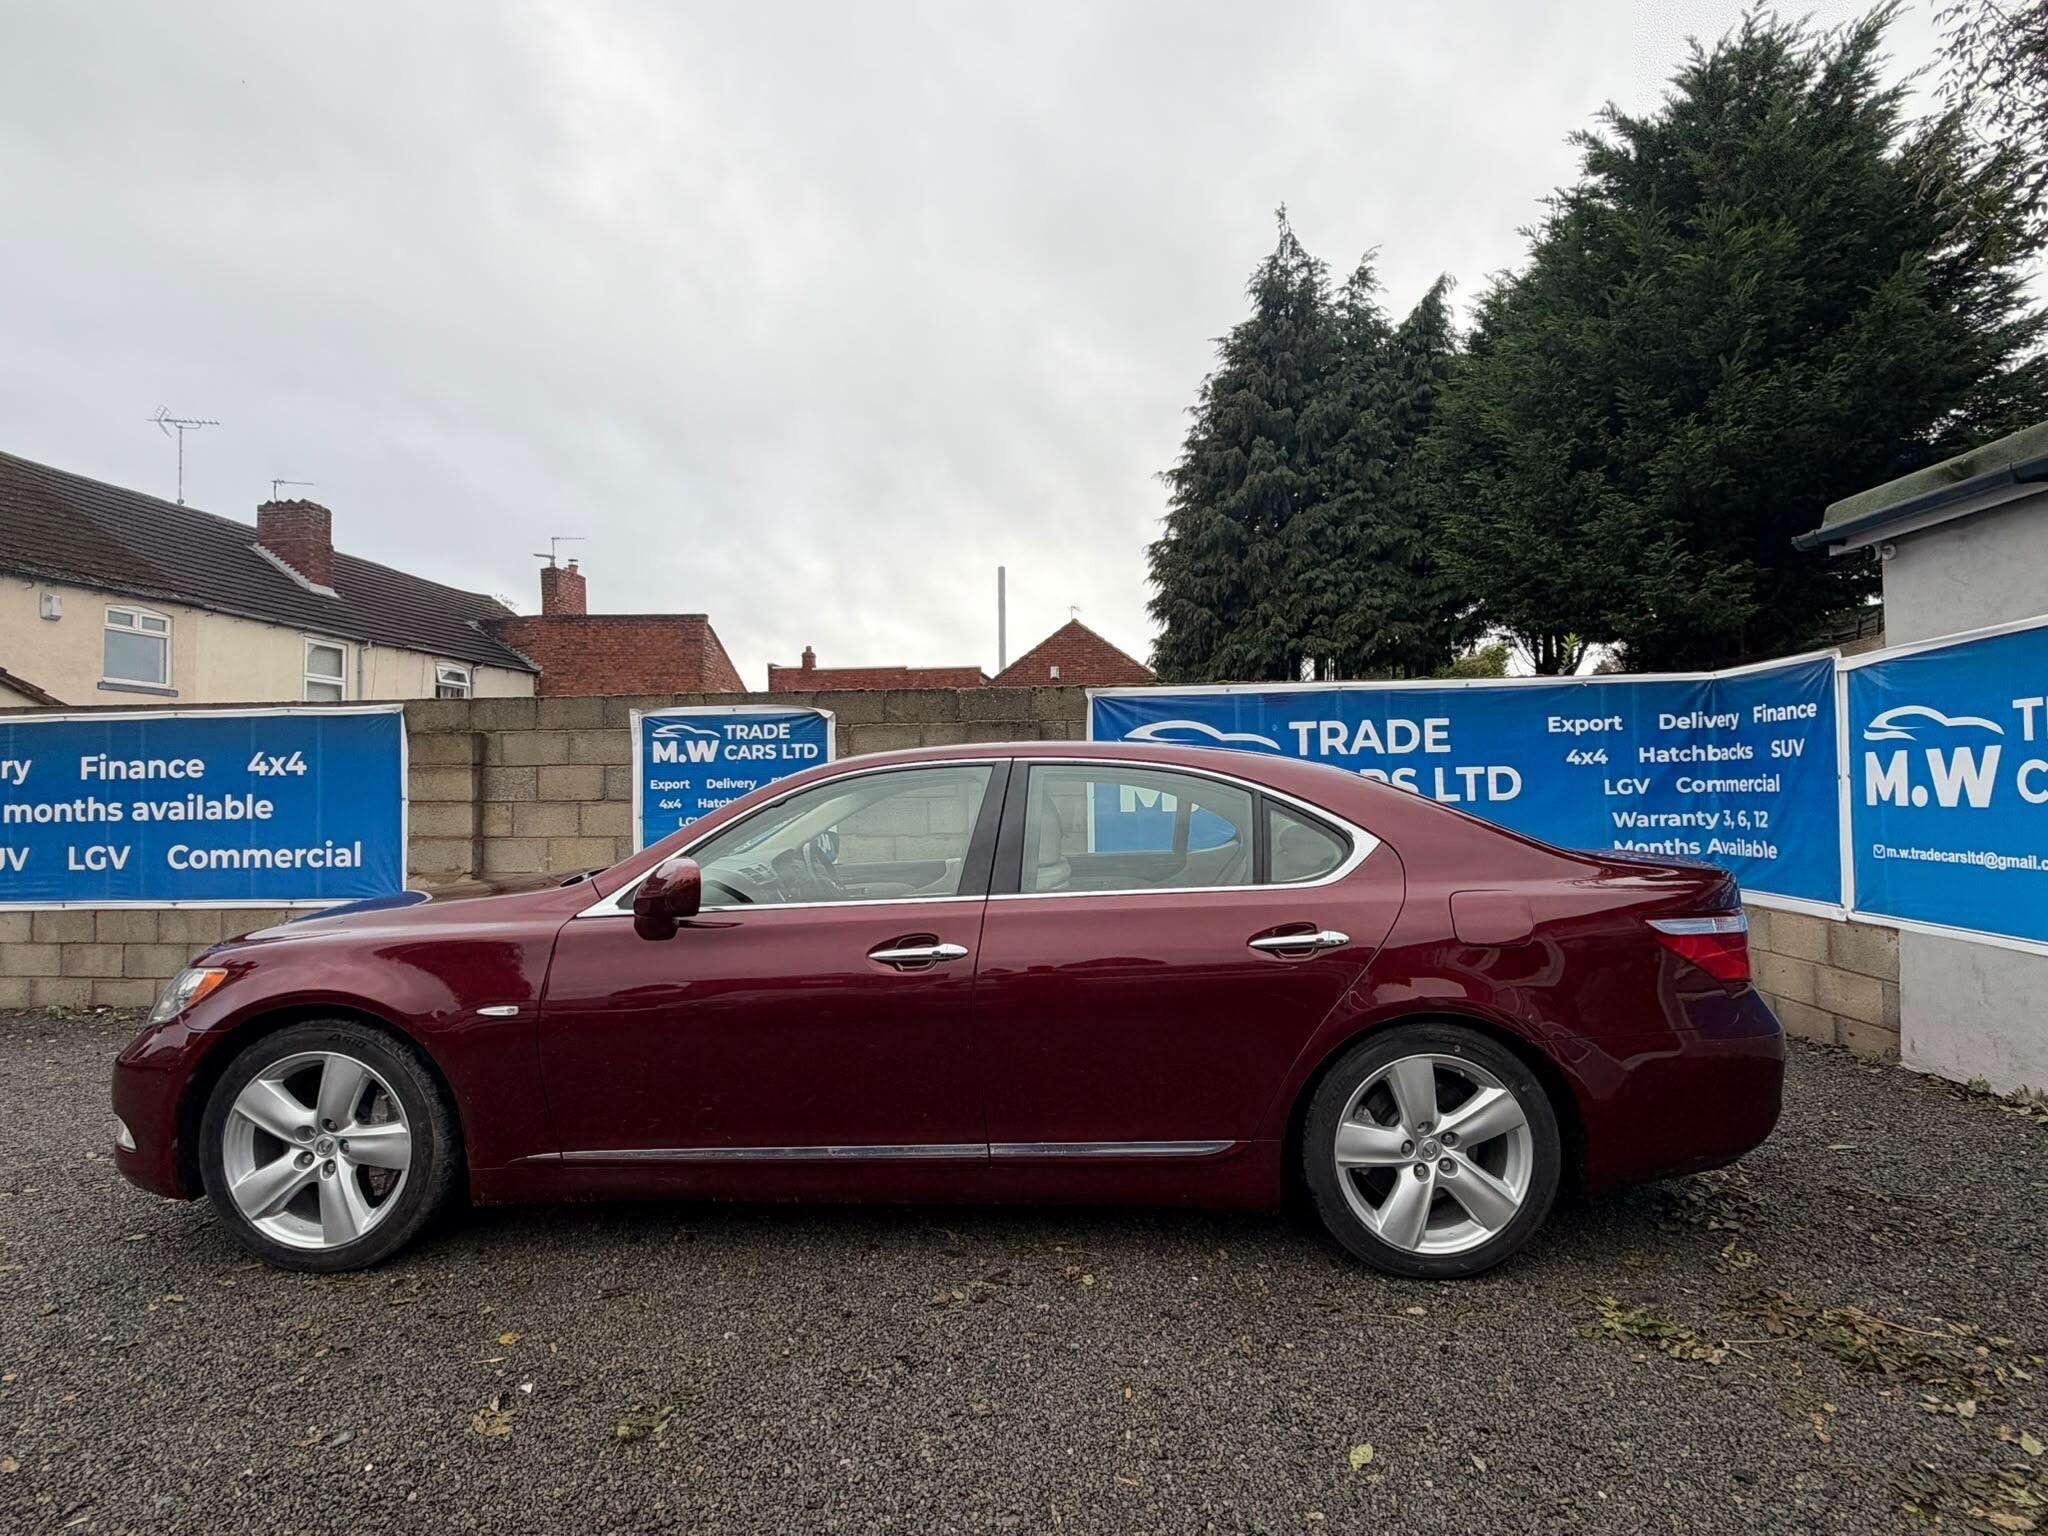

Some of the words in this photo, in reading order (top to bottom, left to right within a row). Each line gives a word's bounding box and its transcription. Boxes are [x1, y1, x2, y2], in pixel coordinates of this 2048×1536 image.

[1548, 716, 1622, 735] Export
[1660, 712, 1739, 729] Delivery
[1754, 703, 1816, 722] Finance
[724, 723, 790, 739] TRADE
[1288, 717, 1451, 756] TRADE
[653, 740, 719, 763] M.W
[725, 745, 776, 760] CARS
[783, 744, 818, 759] LTD
[1567, 749, 1608, 764] 4x4
[1640, 743, 1753, 762] Hatchbacks
[1772, 739, 1804, 757] SUV
[81, 754, 204, 779] Finance
[248, 752, 307, 775] 4x4
[1865, 745, 2002, 808] M.W
[650, 779, 691, 792] Export
[706, 777, 757, 790] Delivery
[1434, 765, 1522, 802] LTD
[1605, 779, 1650, 794] LGV
[1676, 774, 1779, 793] Commercial
[4, 797, 123, 823] months
[132, 794, 273, 821] available
[659, 798, 682, 809] 4x4
[678, 816, 698, 827] LG
[1613, 812, 1719, 829] Warranty
[1724, 810, 1734, 828] 3,
[1738, 811, 1750, 829] 6,
[1754, 811, 1767, 827] 12
[69, 846, 130, 870] LGV
[168, 840, 361, 869] Commercial
[1613, 838, 1700, 855] Months
[1707, 839, 1777, 858] Available
